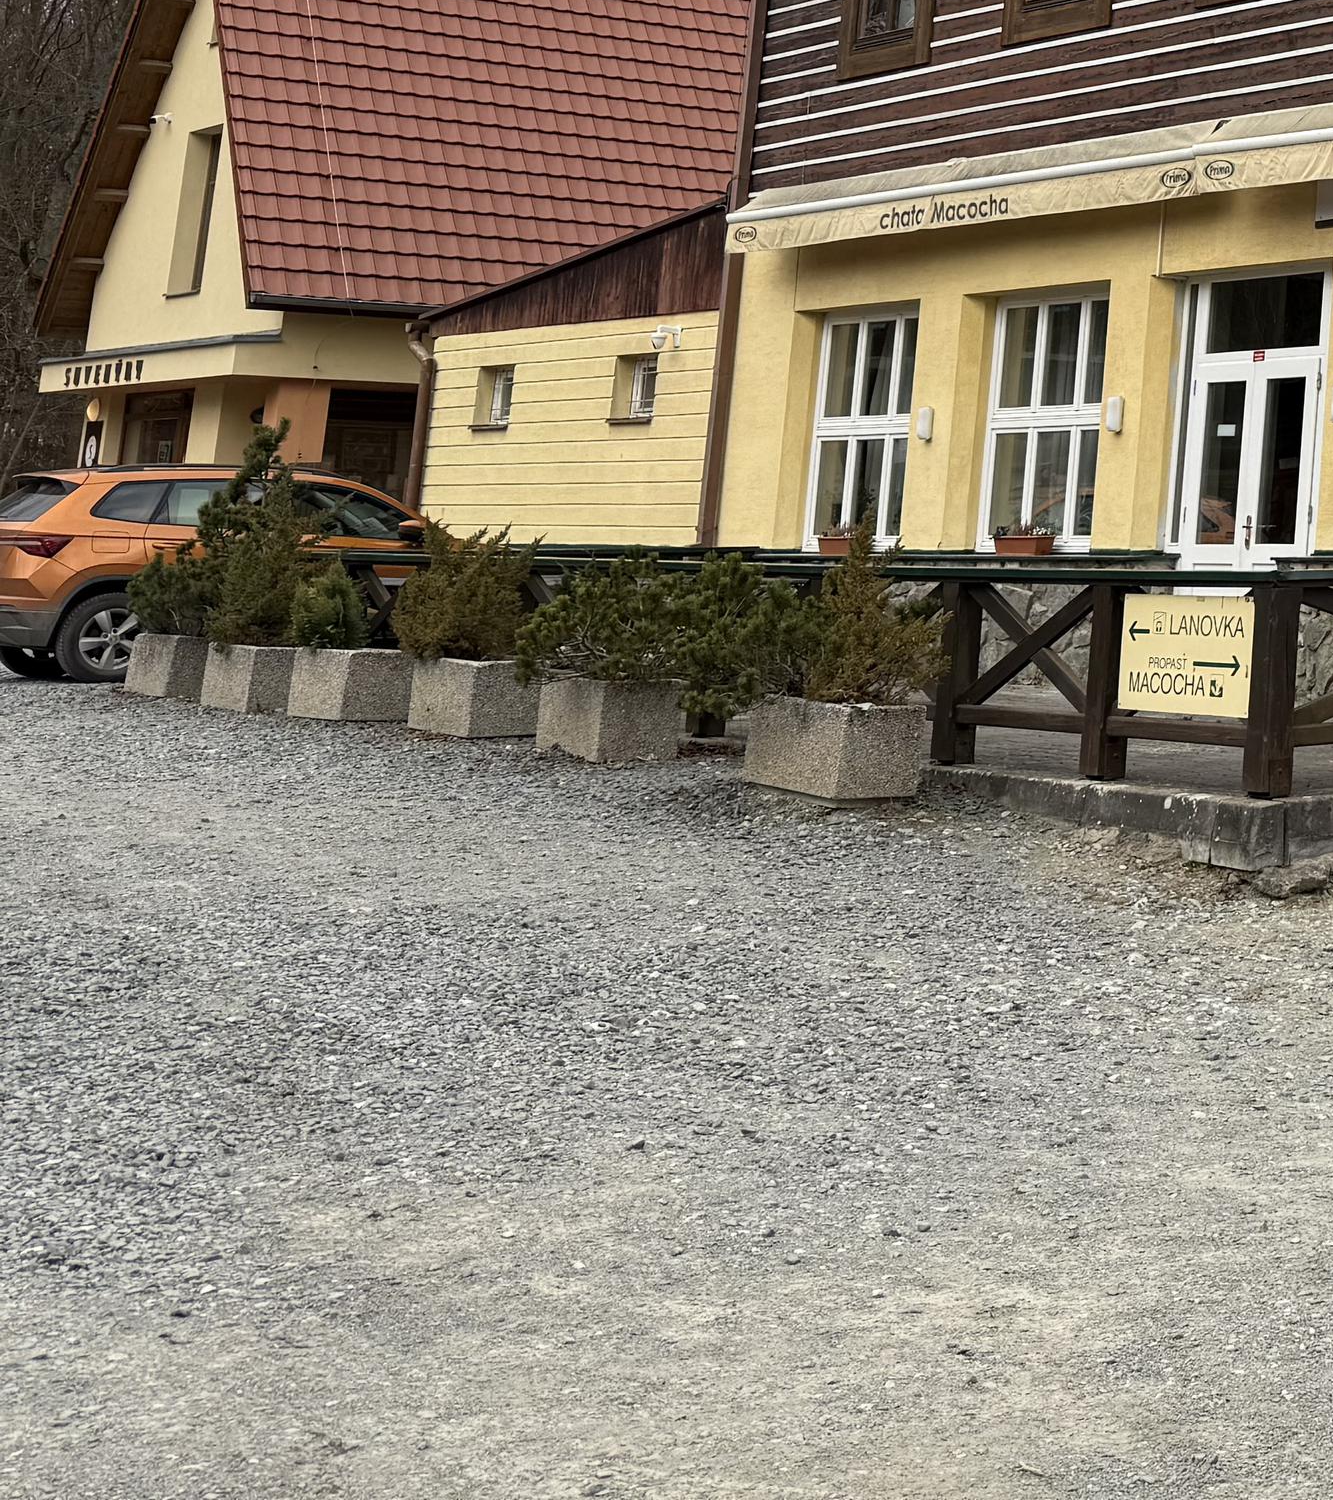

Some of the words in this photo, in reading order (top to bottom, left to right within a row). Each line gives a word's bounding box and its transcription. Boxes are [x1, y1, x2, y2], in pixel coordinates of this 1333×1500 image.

[930, 194, 1008, 223] Macocha
[1170, 614, 1245, 638] LANOVKA
[1148, 656, 1188, 670] PROPAST
[1129, 671, 1205, 697] MACOCHA
